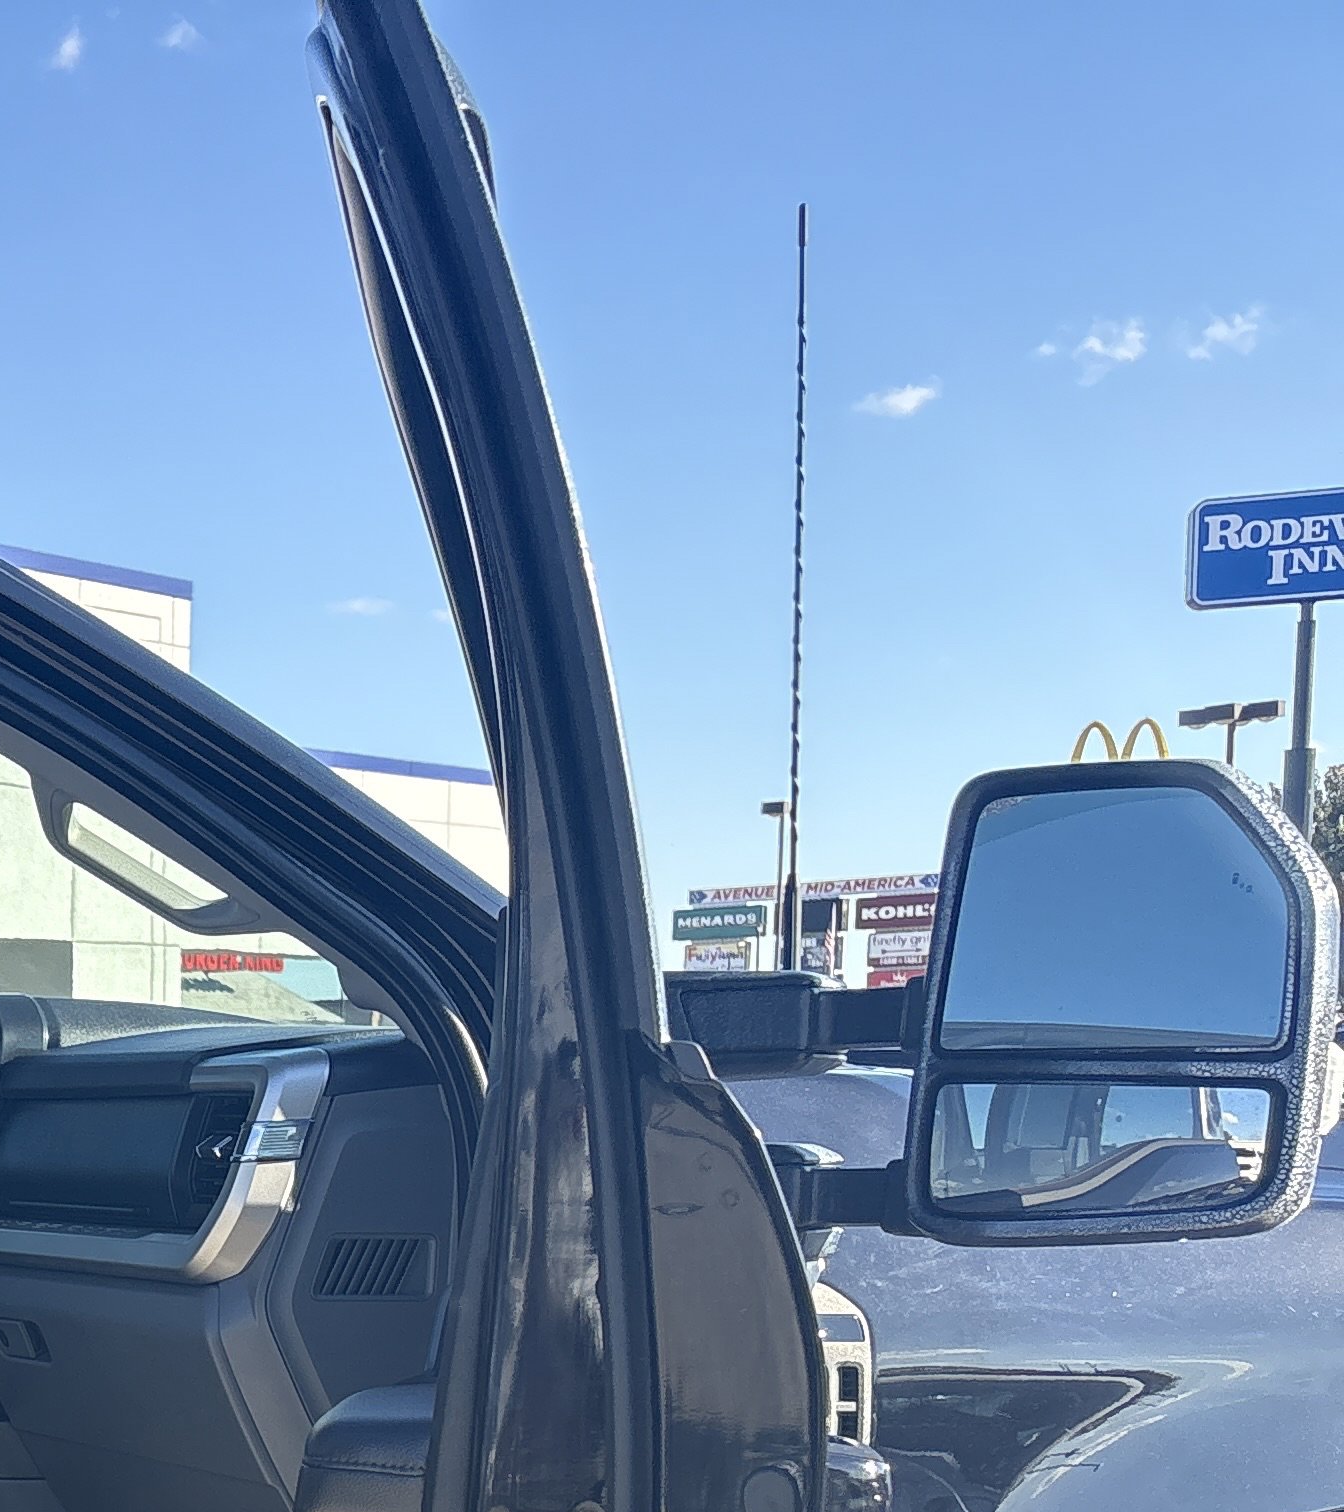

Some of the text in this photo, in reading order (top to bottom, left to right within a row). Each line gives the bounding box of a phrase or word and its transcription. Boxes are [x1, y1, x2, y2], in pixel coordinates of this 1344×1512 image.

[712, 876, 916, 901] AVENUE MID-AMERICA
[677, 913, 757, 929] MENARDS
